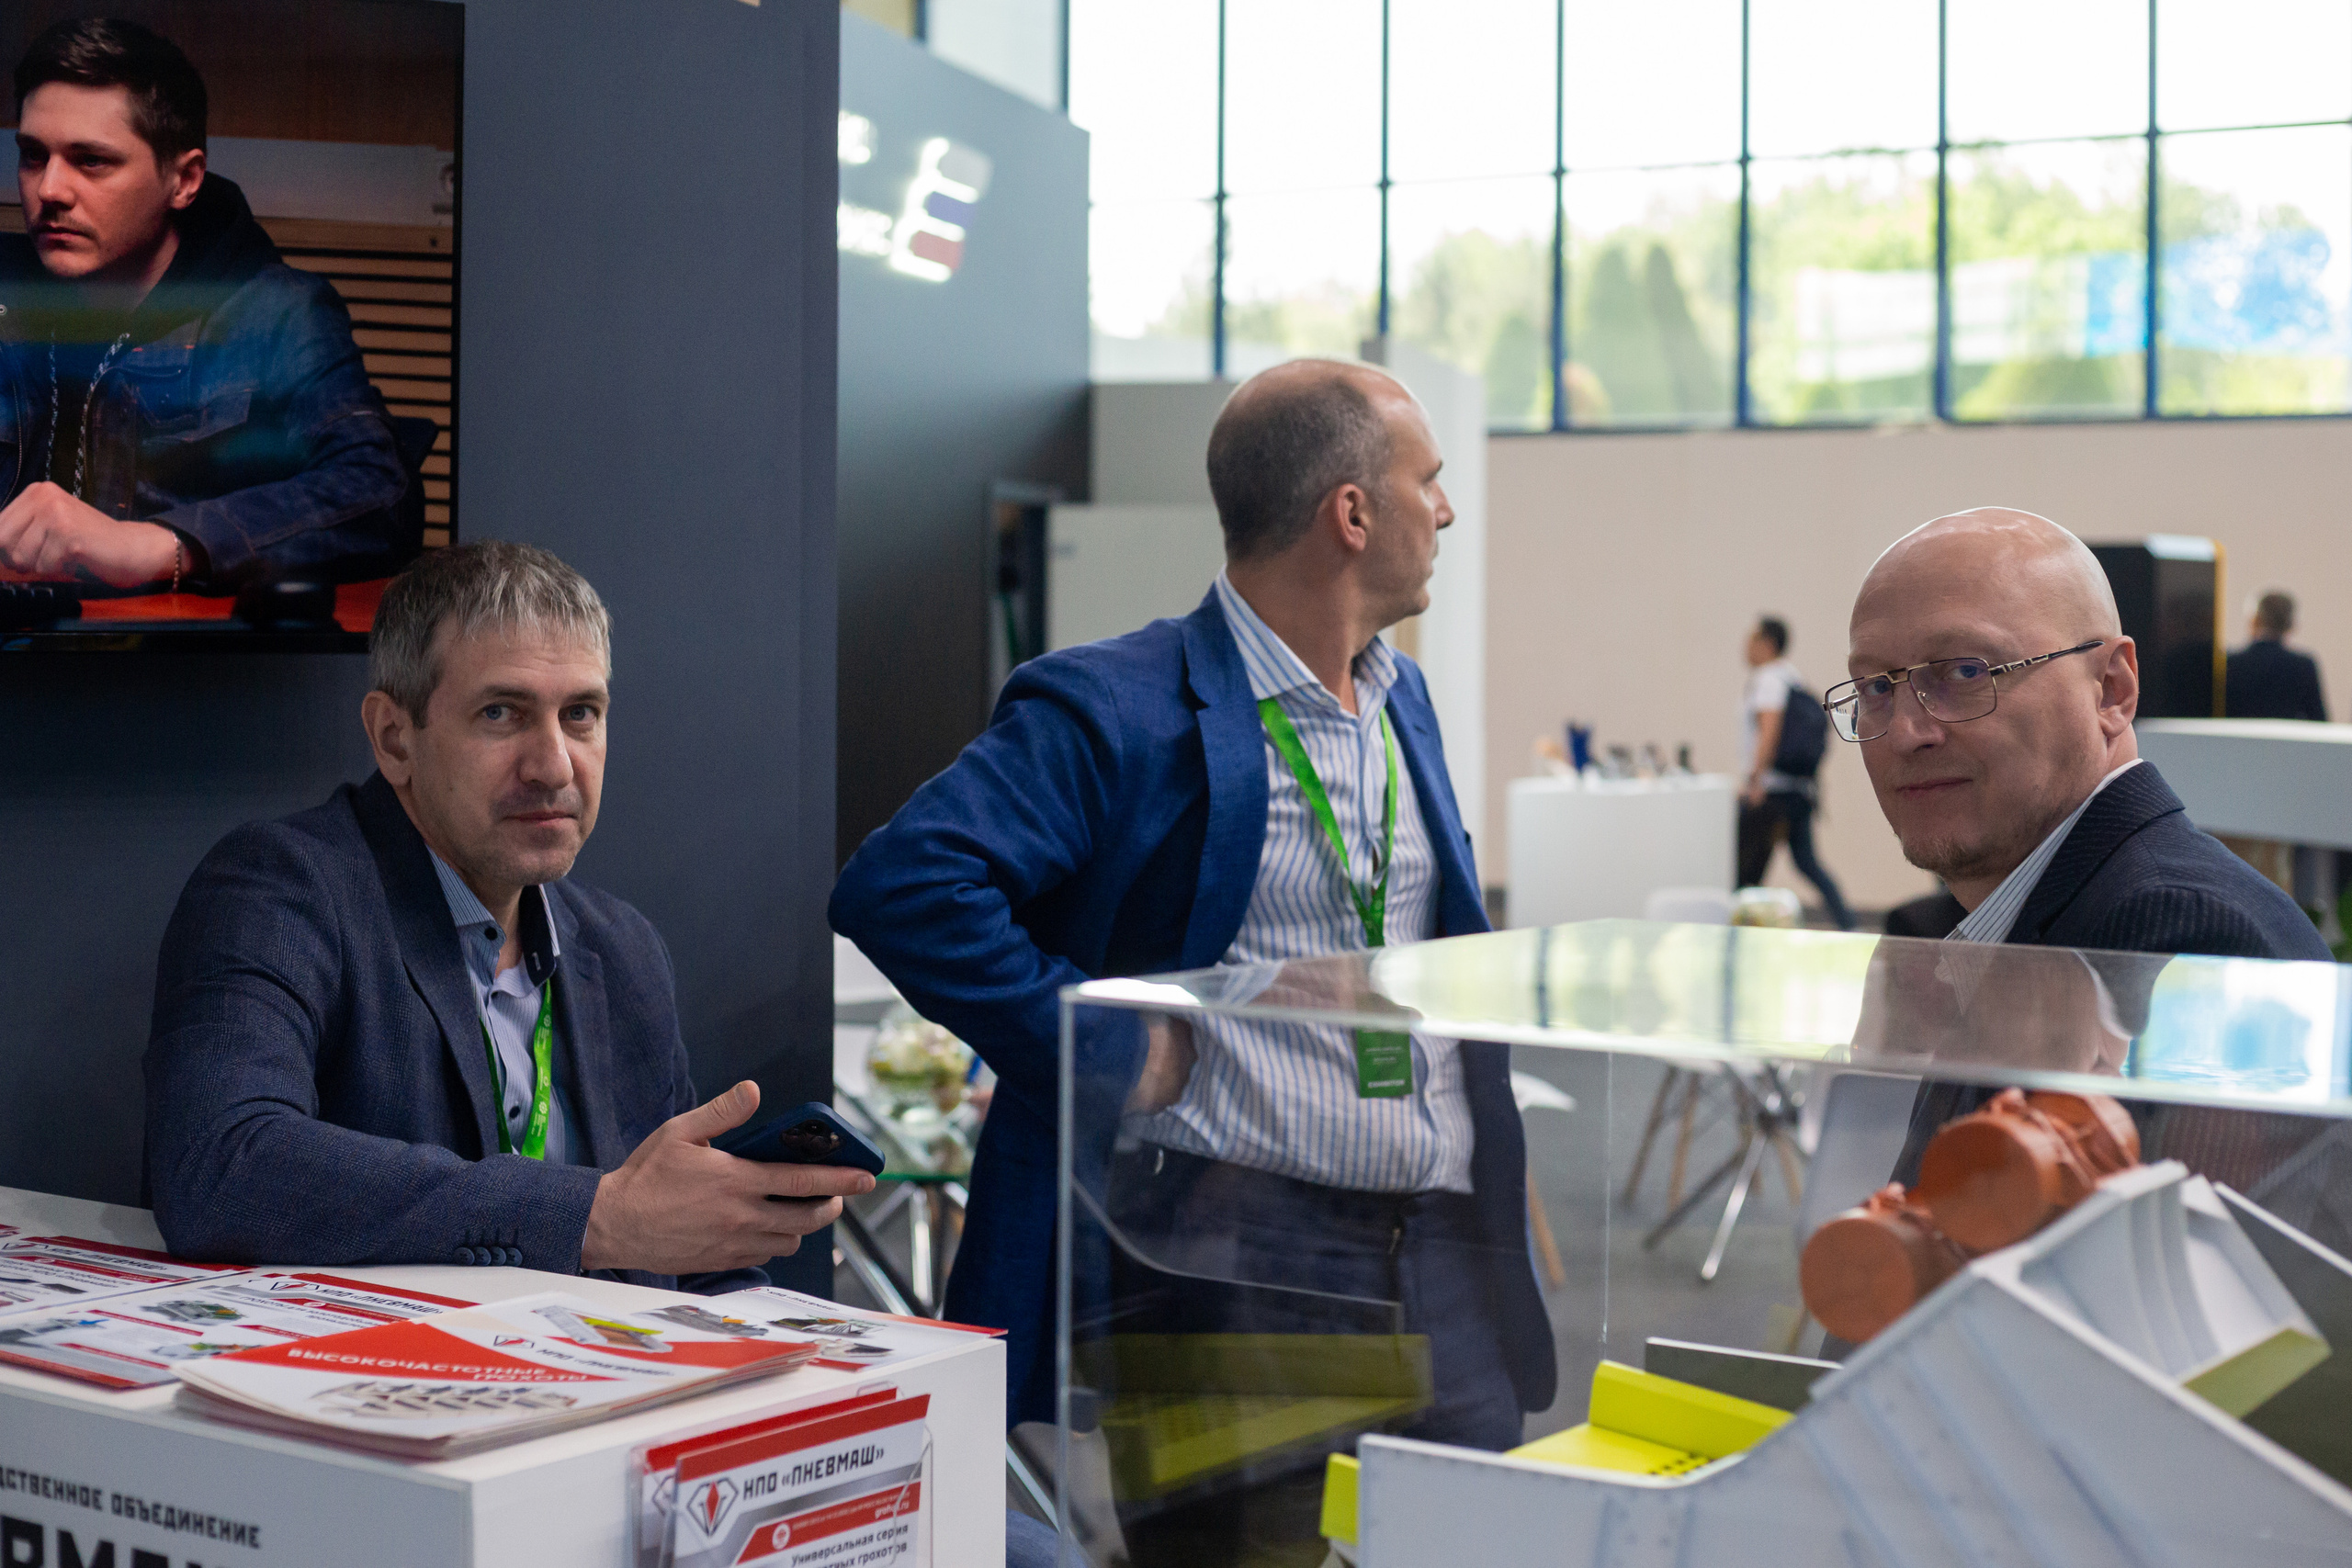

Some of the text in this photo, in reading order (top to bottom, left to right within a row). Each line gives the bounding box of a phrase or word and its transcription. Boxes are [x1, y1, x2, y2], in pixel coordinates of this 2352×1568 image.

[318, 1288, 351, 1297] НПО
[352, 1293, 443, 1314] «ПНЕВМАШ»
[287, 1347, 548, 1376] ВЫСОКОЧАСТОТНЫЕ
[742, 1444, 884, 1500] НПО «ПНЕВМАШ»
[110, 1492, 260, 1550] ОБЪЕДИНЕНИЕ
[792, 1524, 908, 1567] Универсальная серия
